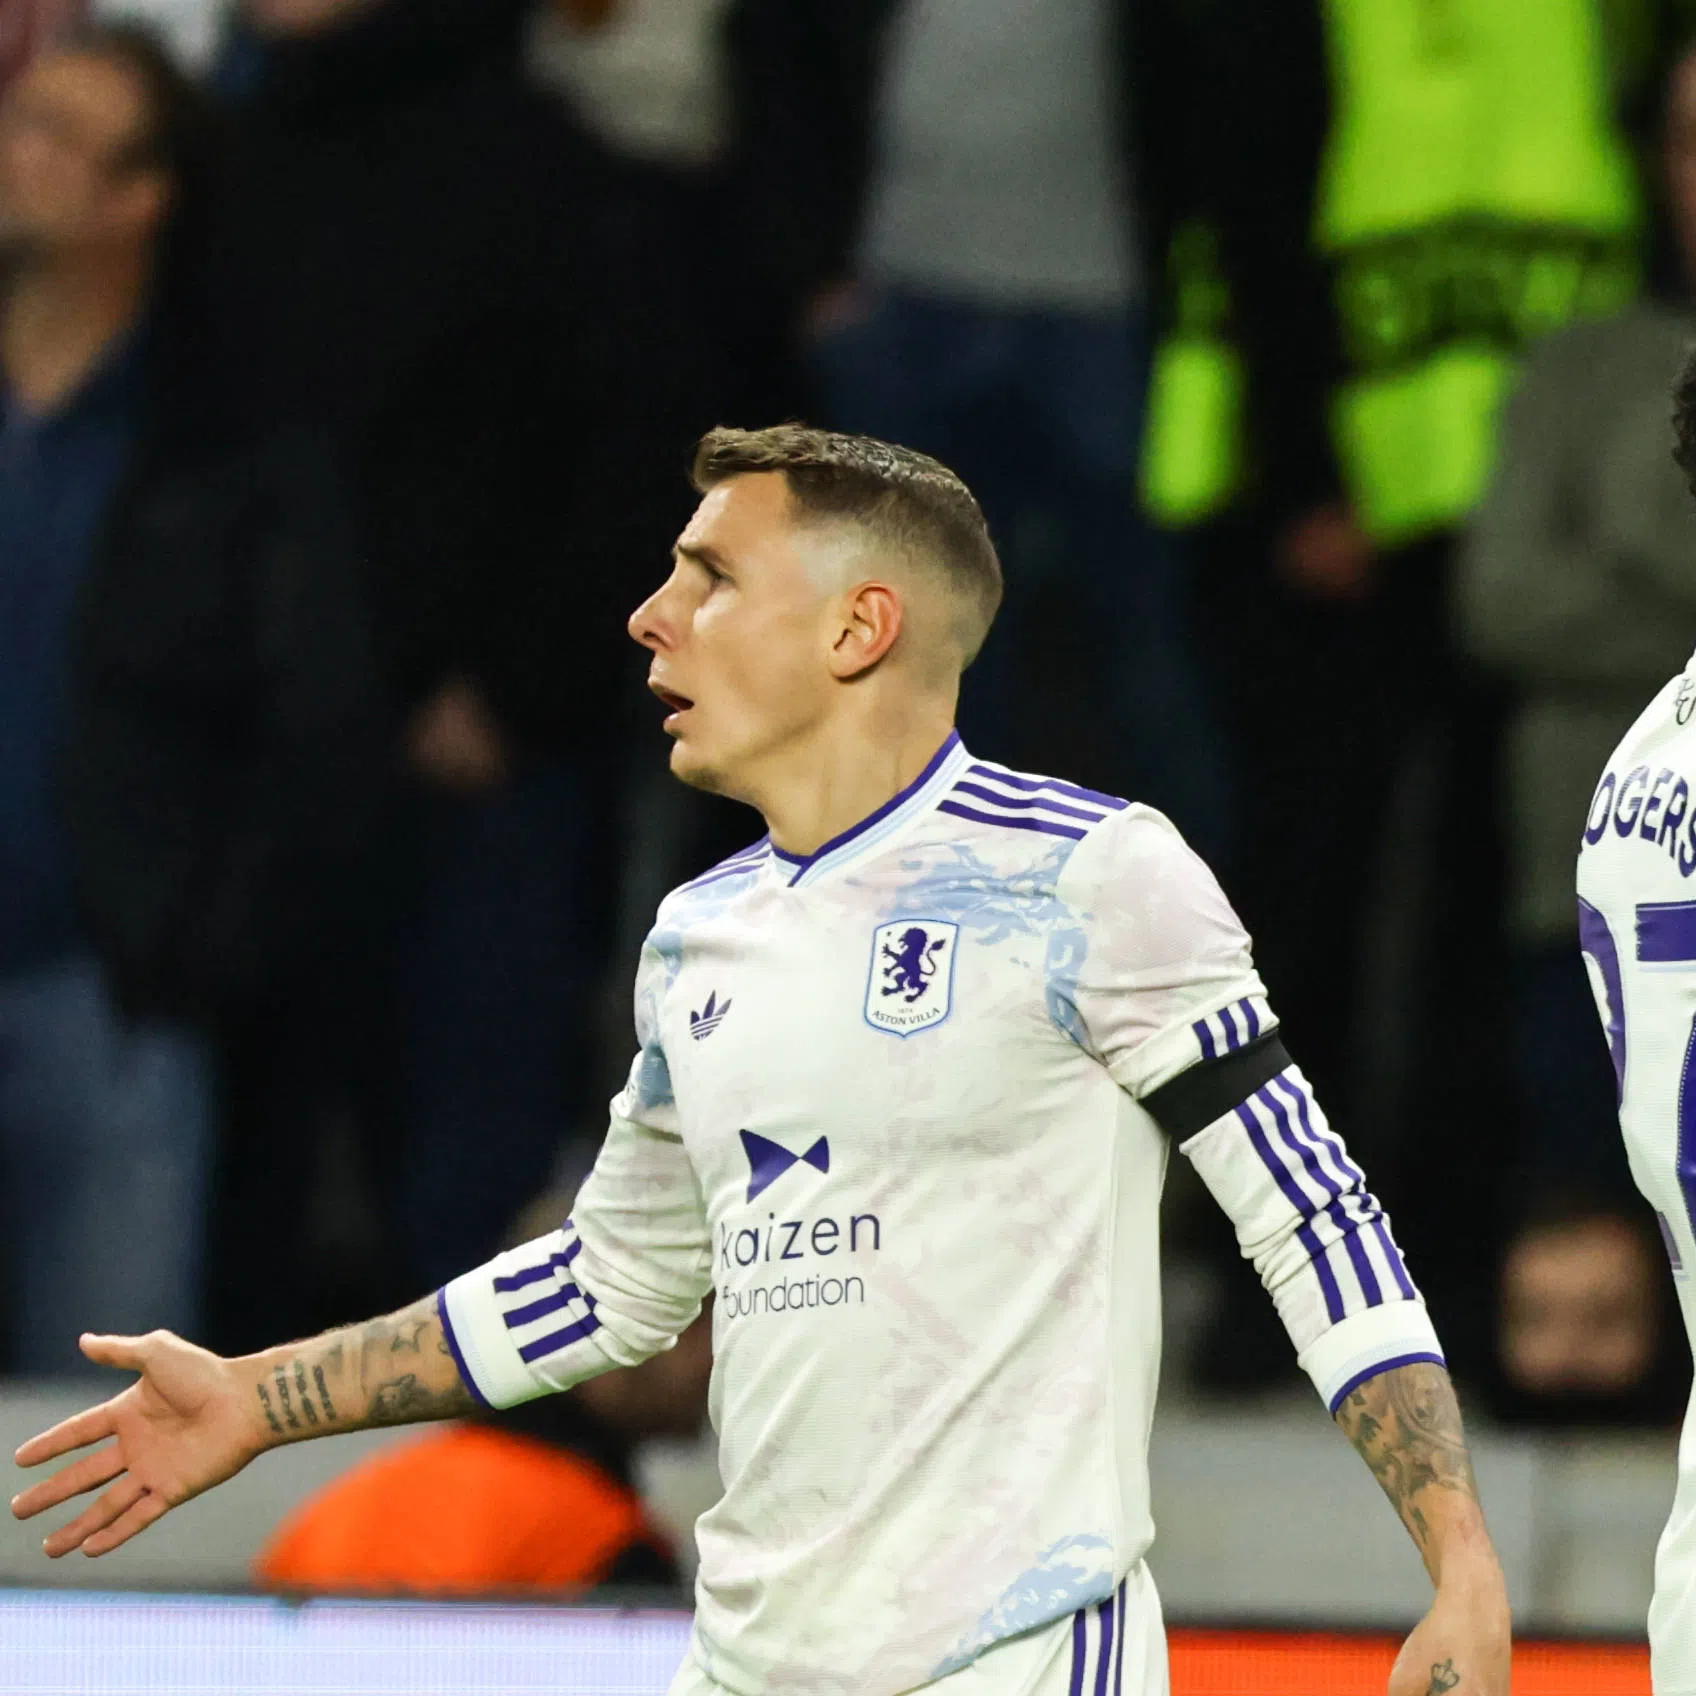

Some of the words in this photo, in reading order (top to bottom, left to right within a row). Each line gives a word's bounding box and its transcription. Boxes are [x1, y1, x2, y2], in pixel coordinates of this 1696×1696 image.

[872, 1010, 906, 1025] ASTON
[909, 1007, 940, 1024] VILLA
[720, 1212, 880, 1271] kaizen
[722, 1274, 865, 1319] foundation
